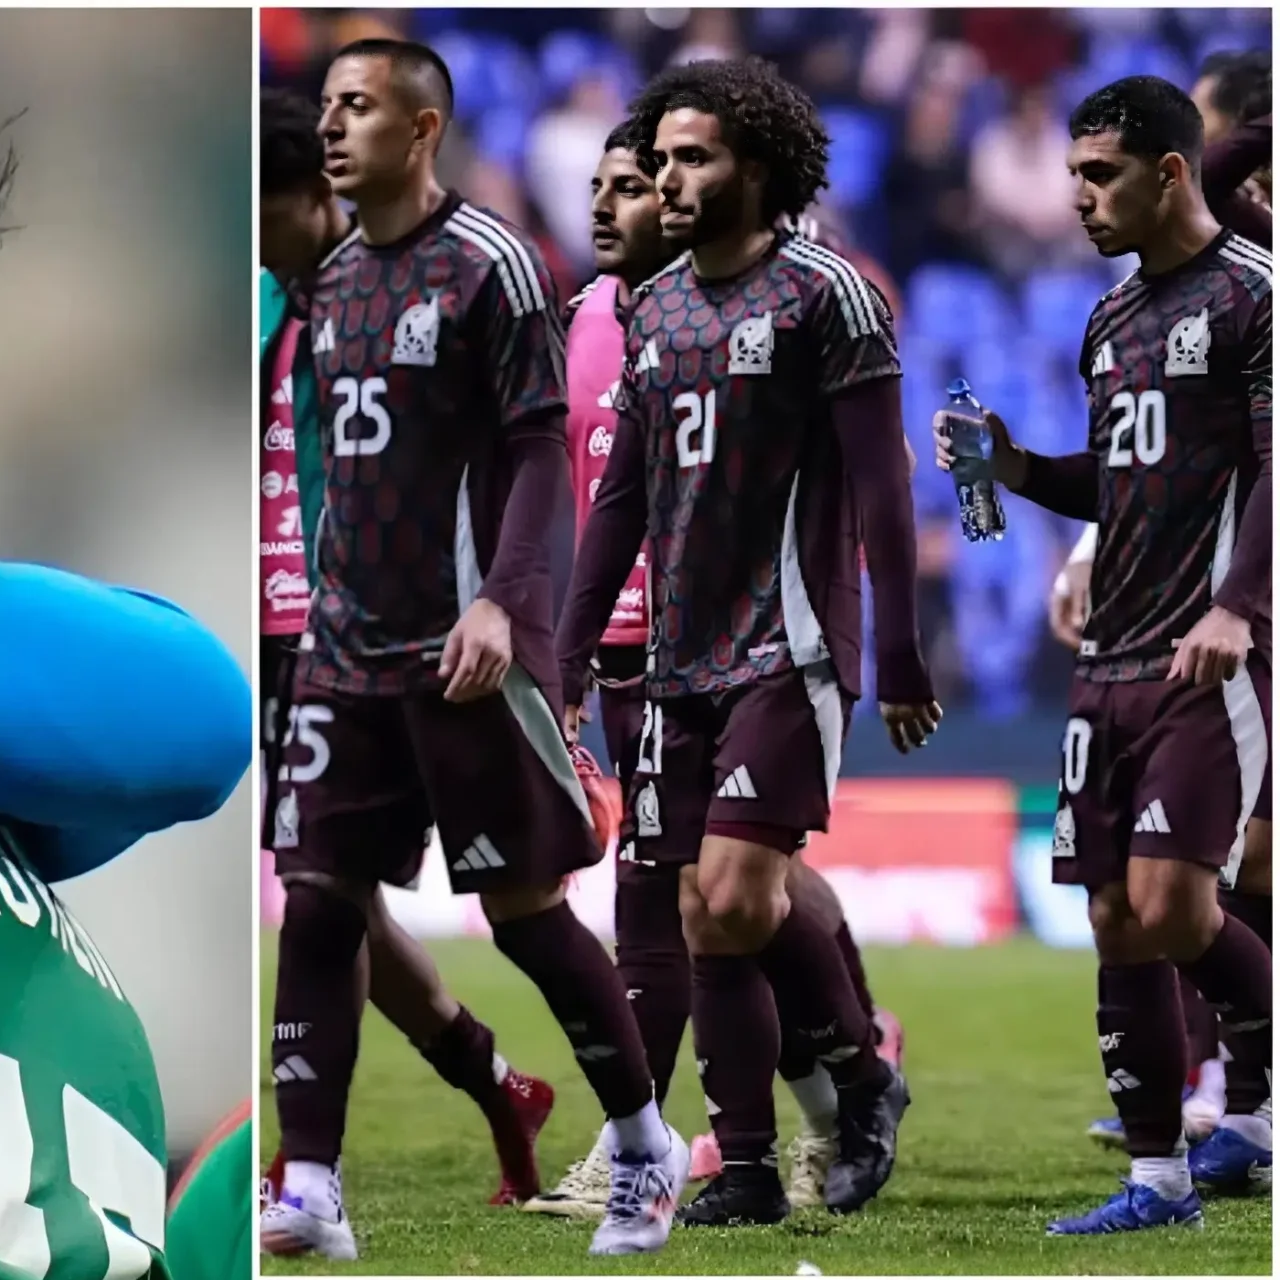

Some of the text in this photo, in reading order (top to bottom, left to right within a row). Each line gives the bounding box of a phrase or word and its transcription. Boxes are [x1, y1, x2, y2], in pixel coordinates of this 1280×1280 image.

[332, 376, 392, 457] 25
[673, 388, 716, 468] 21
[1107, 389, 1166, 468] 20
[1058, 717, 1093, 794] 0
